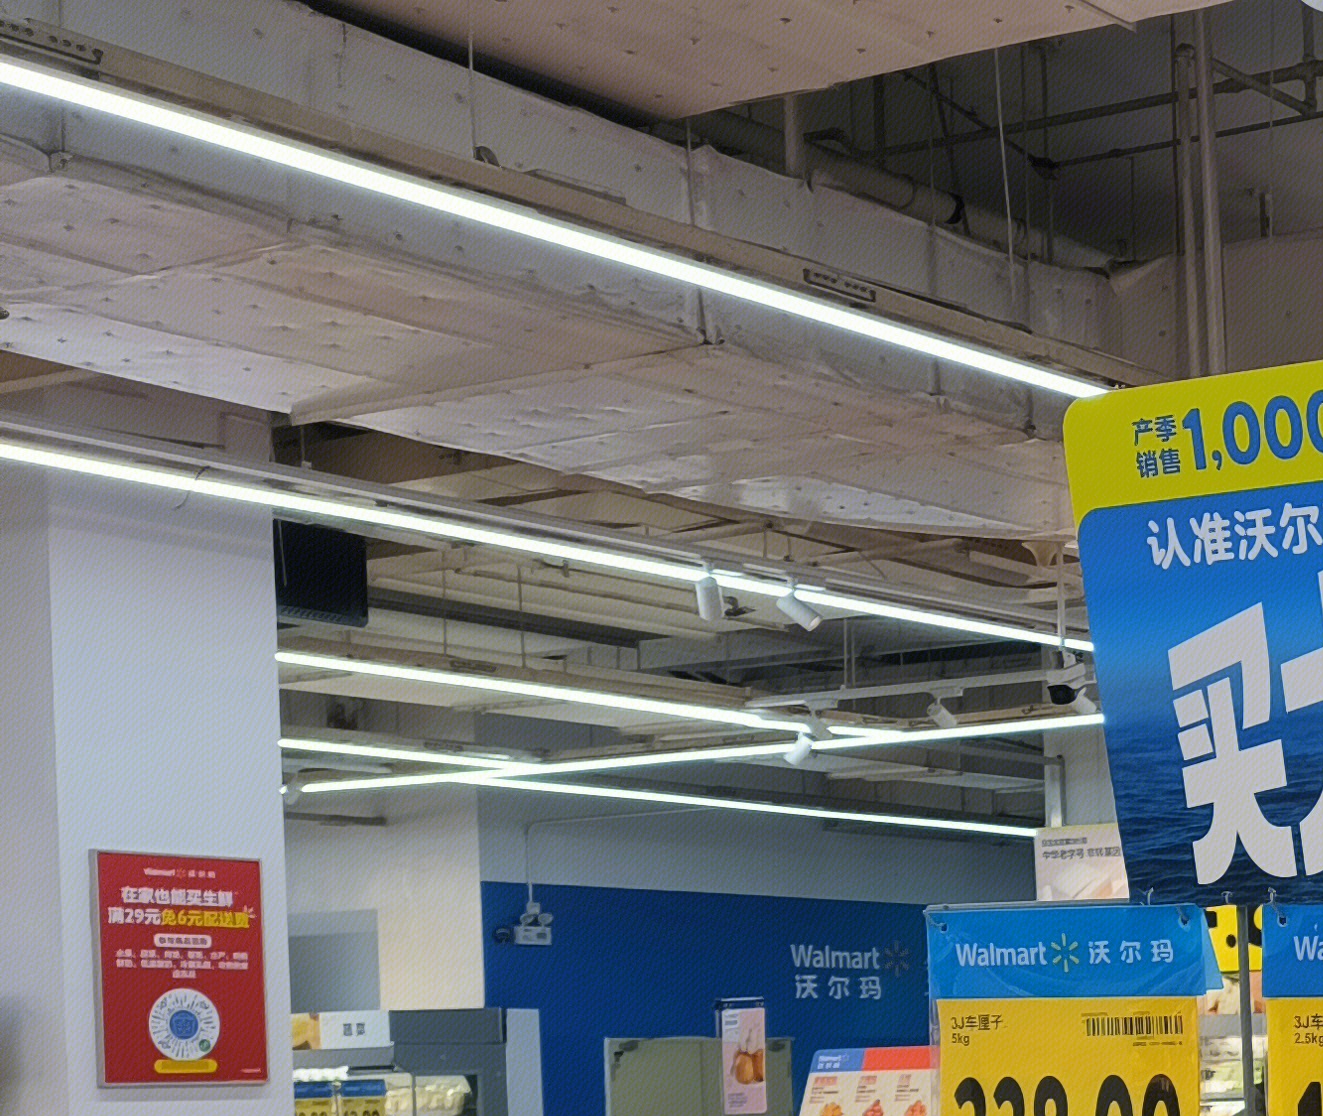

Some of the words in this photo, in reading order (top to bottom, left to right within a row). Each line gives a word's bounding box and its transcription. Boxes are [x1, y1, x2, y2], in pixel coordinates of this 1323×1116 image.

[1131, 414, 1178, 445] 产季
[1136, 447, 1182, 478] 销售
[790, 944, 880, 970] Walmart
[956, 941, 1047, 969] Walmart
[1088, 939, 1175, 964] 沃尔玛
[794, 974, 882, 1000] 沃尔玛
[950, 1033, 971, 1048] 5kg
